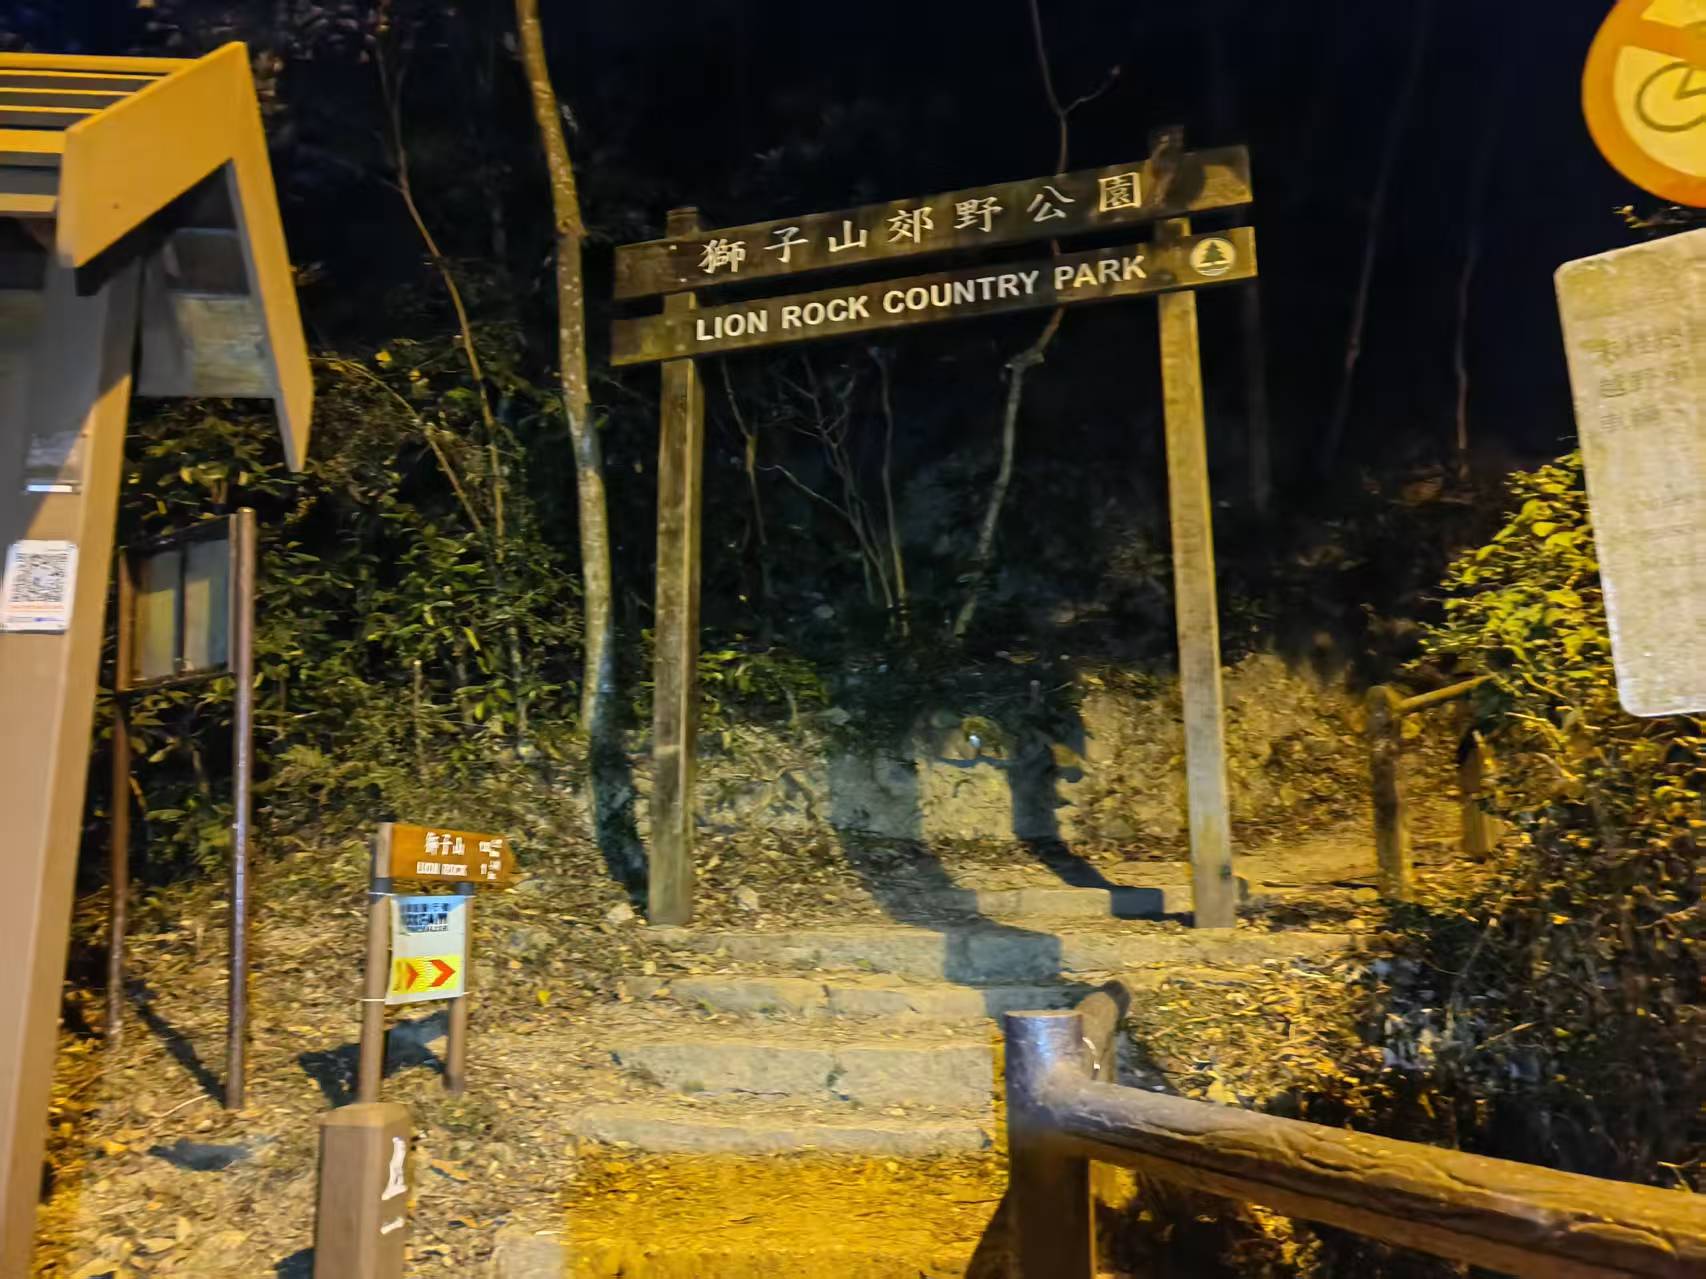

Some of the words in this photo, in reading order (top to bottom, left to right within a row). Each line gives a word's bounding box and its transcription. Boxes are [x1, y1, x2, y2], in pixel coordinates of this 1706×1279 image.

[698, 171, 1142, 274] 獅子山郊野公園
[696, 309, 768, 341] LION
[781, 295, 870, 329] ROCK
[882, 270, 1040, 314] COUNTRY
[1054, 254, 1148, 290] PARK
